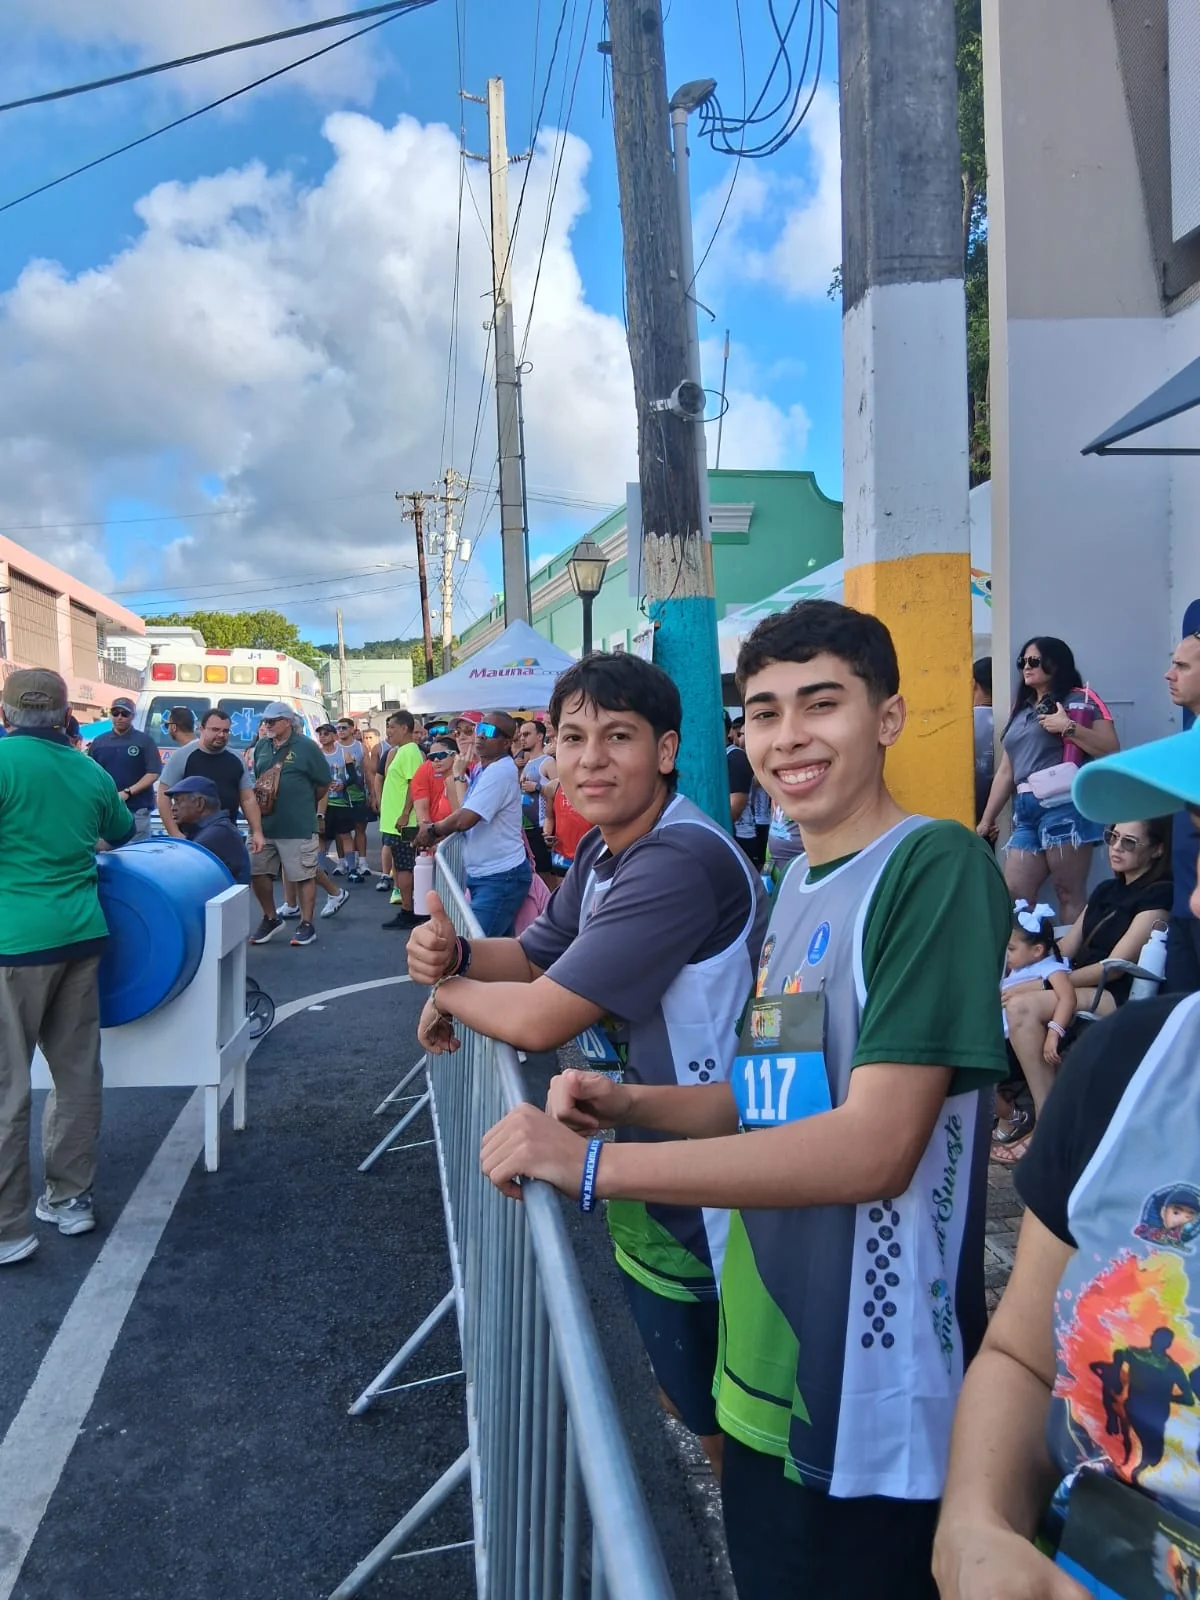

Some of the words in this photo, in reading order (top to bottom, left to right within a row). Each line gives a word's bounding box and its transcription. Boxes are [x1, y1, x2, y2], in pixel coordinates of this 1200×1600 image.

[247, 652, 262, 660] J-1
[744, 1057, 797, 1121] 117
[932, 1112, 963, 1223] Sureste
